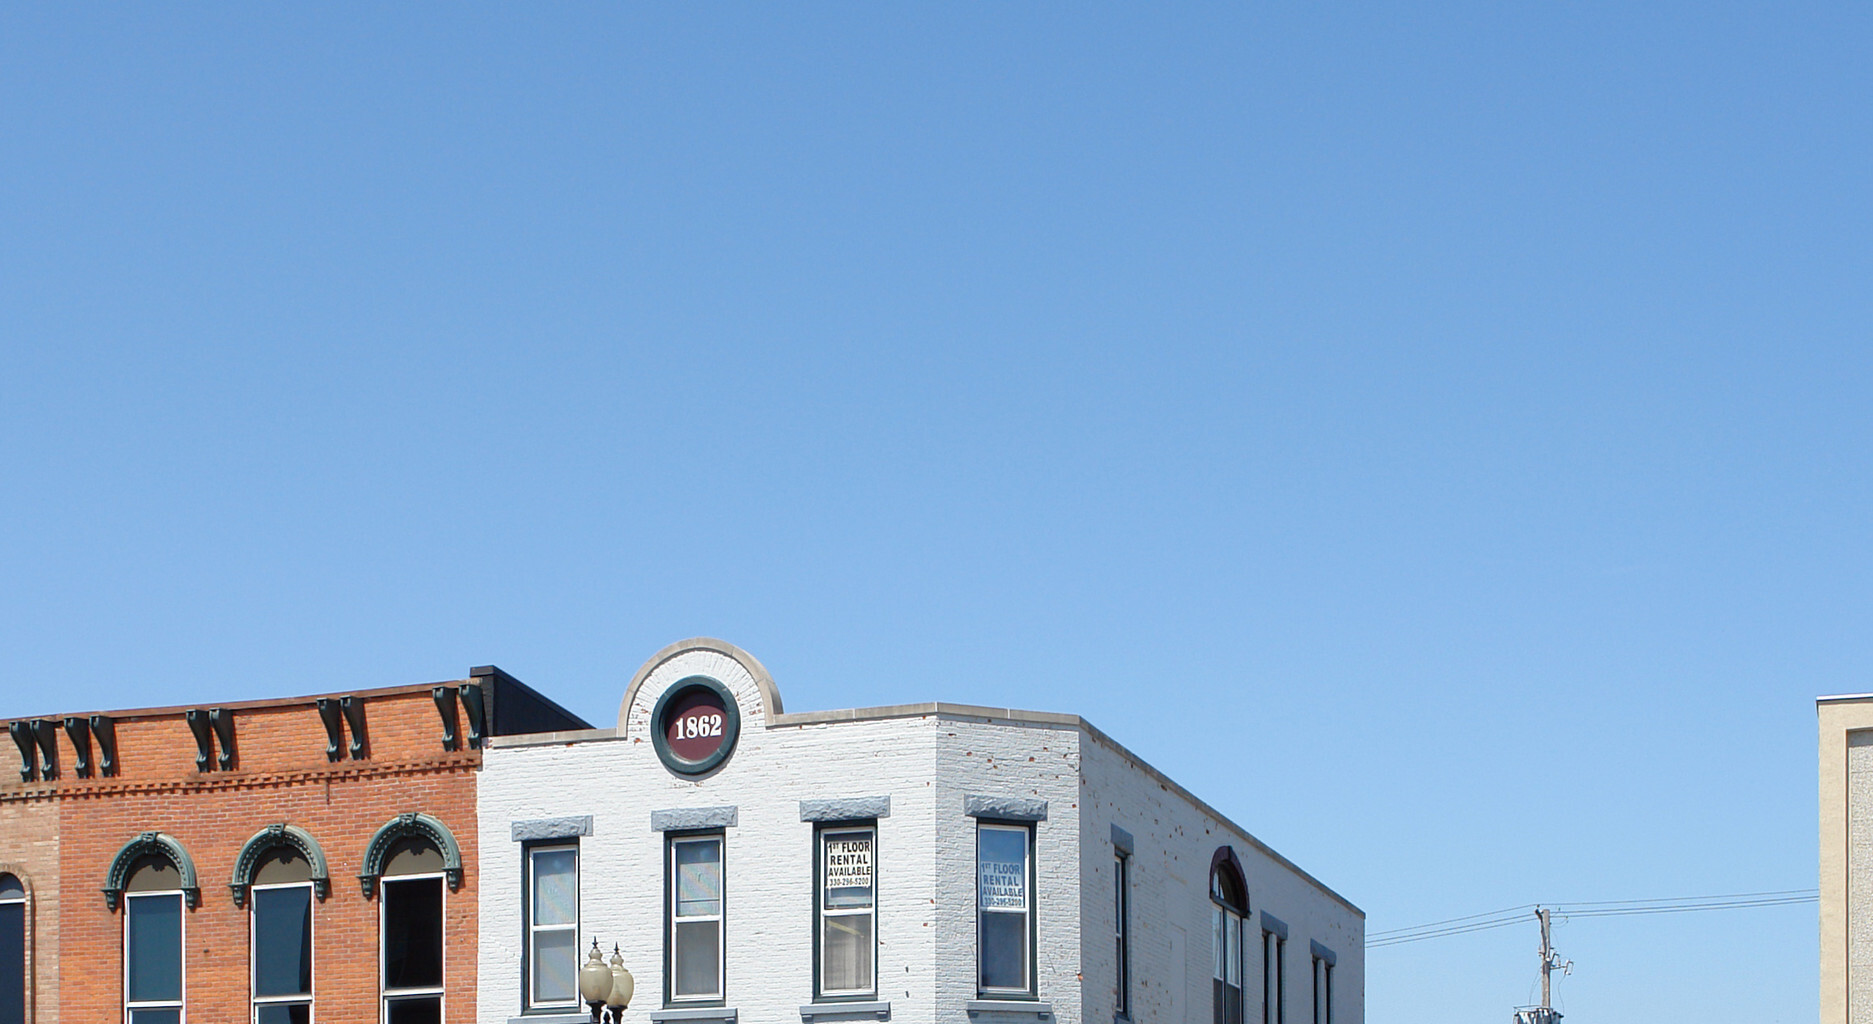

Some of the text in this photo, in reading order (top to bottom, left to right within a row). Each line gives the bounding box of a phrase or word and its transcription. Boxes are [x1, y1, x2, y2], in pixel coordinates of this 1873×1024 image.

[675, 714, 722, 740] 1862
[828, 841, 870, 853] 1ST FLOOR
[830, 854, 868, 866] RENTAL
[828, 866, 871, 877] AVAILABLE
[993, 863, 1020, 875] FLOOR
[829, 877, 869, 887] 330-296-5200
[983, 874, 1019, 887] RENTAL
[982, 886, 1023, 898] AVAILABLE
